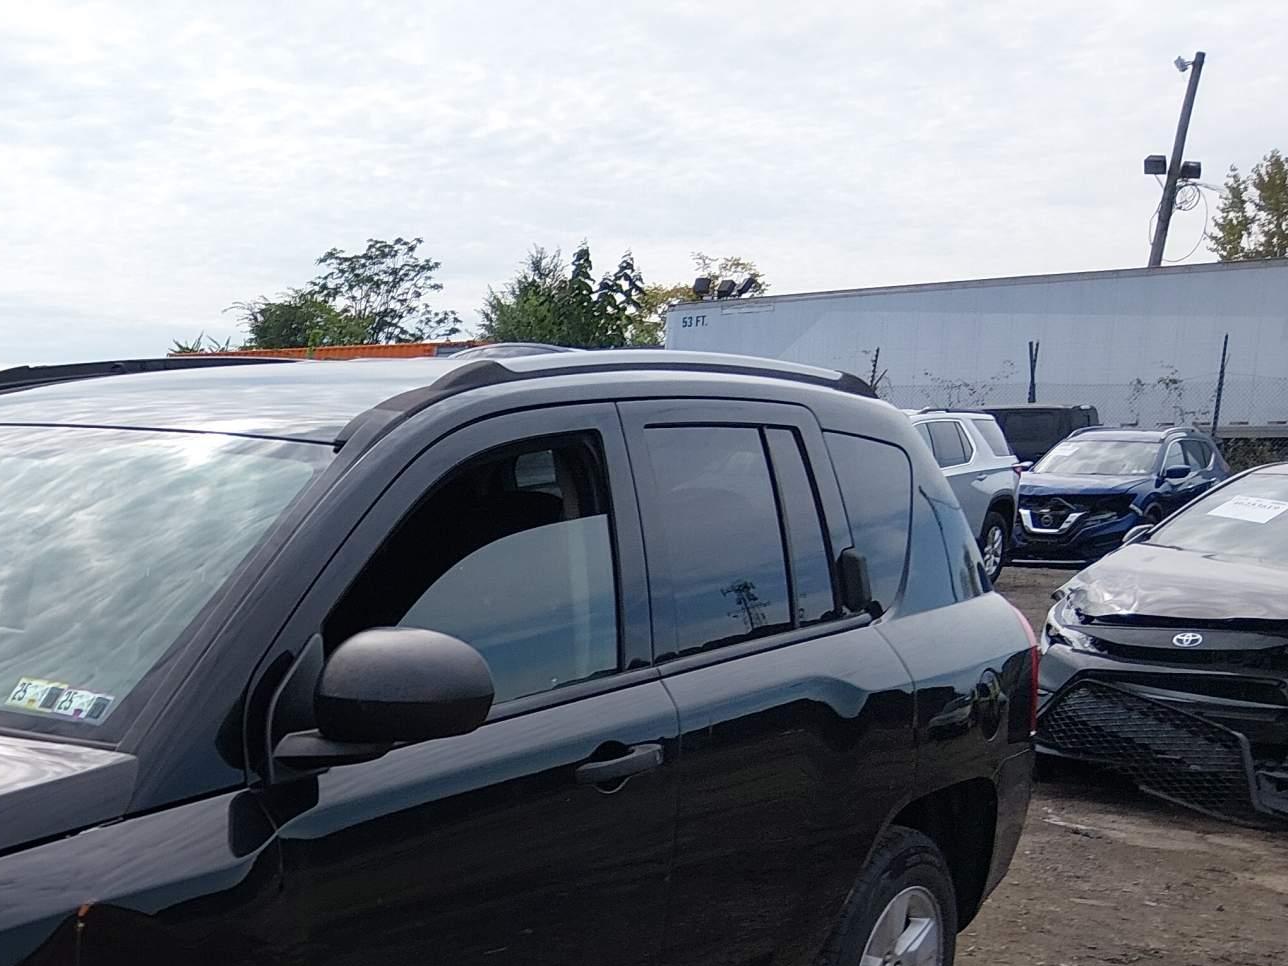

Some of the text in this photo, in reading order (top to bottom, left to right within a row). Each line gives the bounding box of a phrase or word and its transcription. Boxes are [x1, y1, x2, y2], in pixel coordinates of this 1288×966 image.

[682, 315, 708, 328] 53 FT.
[12, 682, 32, 701] 25
[57, 691, 78, 711] 25
